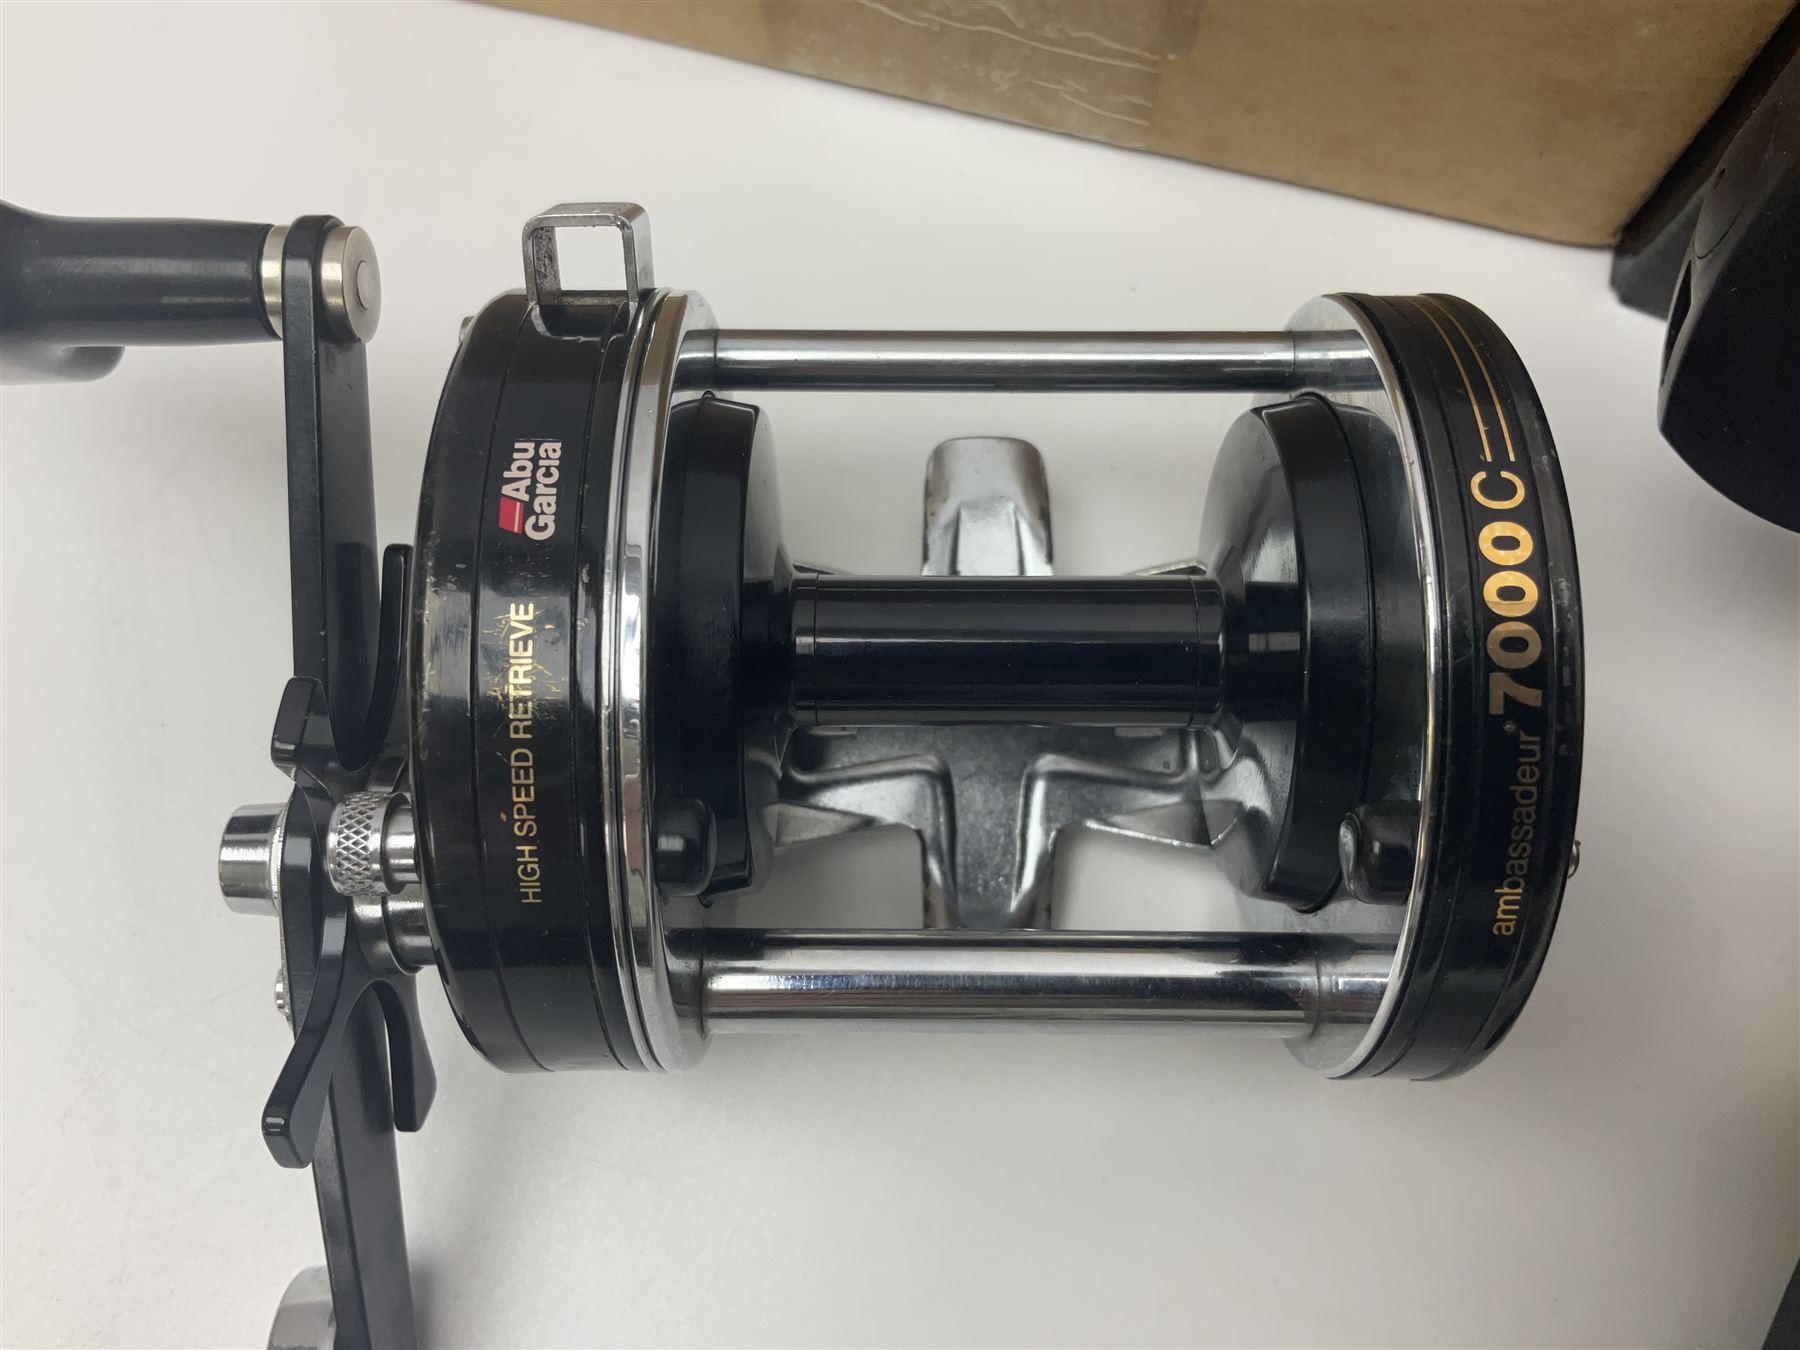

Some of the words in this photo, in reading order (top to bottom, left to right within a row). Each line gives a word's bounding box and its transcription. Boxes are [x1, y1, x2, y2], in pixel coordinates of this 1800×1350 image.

[501, 441, 536, 500] Abu
[524, 440, 563, 541] Garcia
[507, 601, 535, 738] RETRIEVE
[509, 748, 537, 837] SPEED
[1490, 729, 1543, 937] ambassadeur
[516, 844, 543, 904] HIGH
